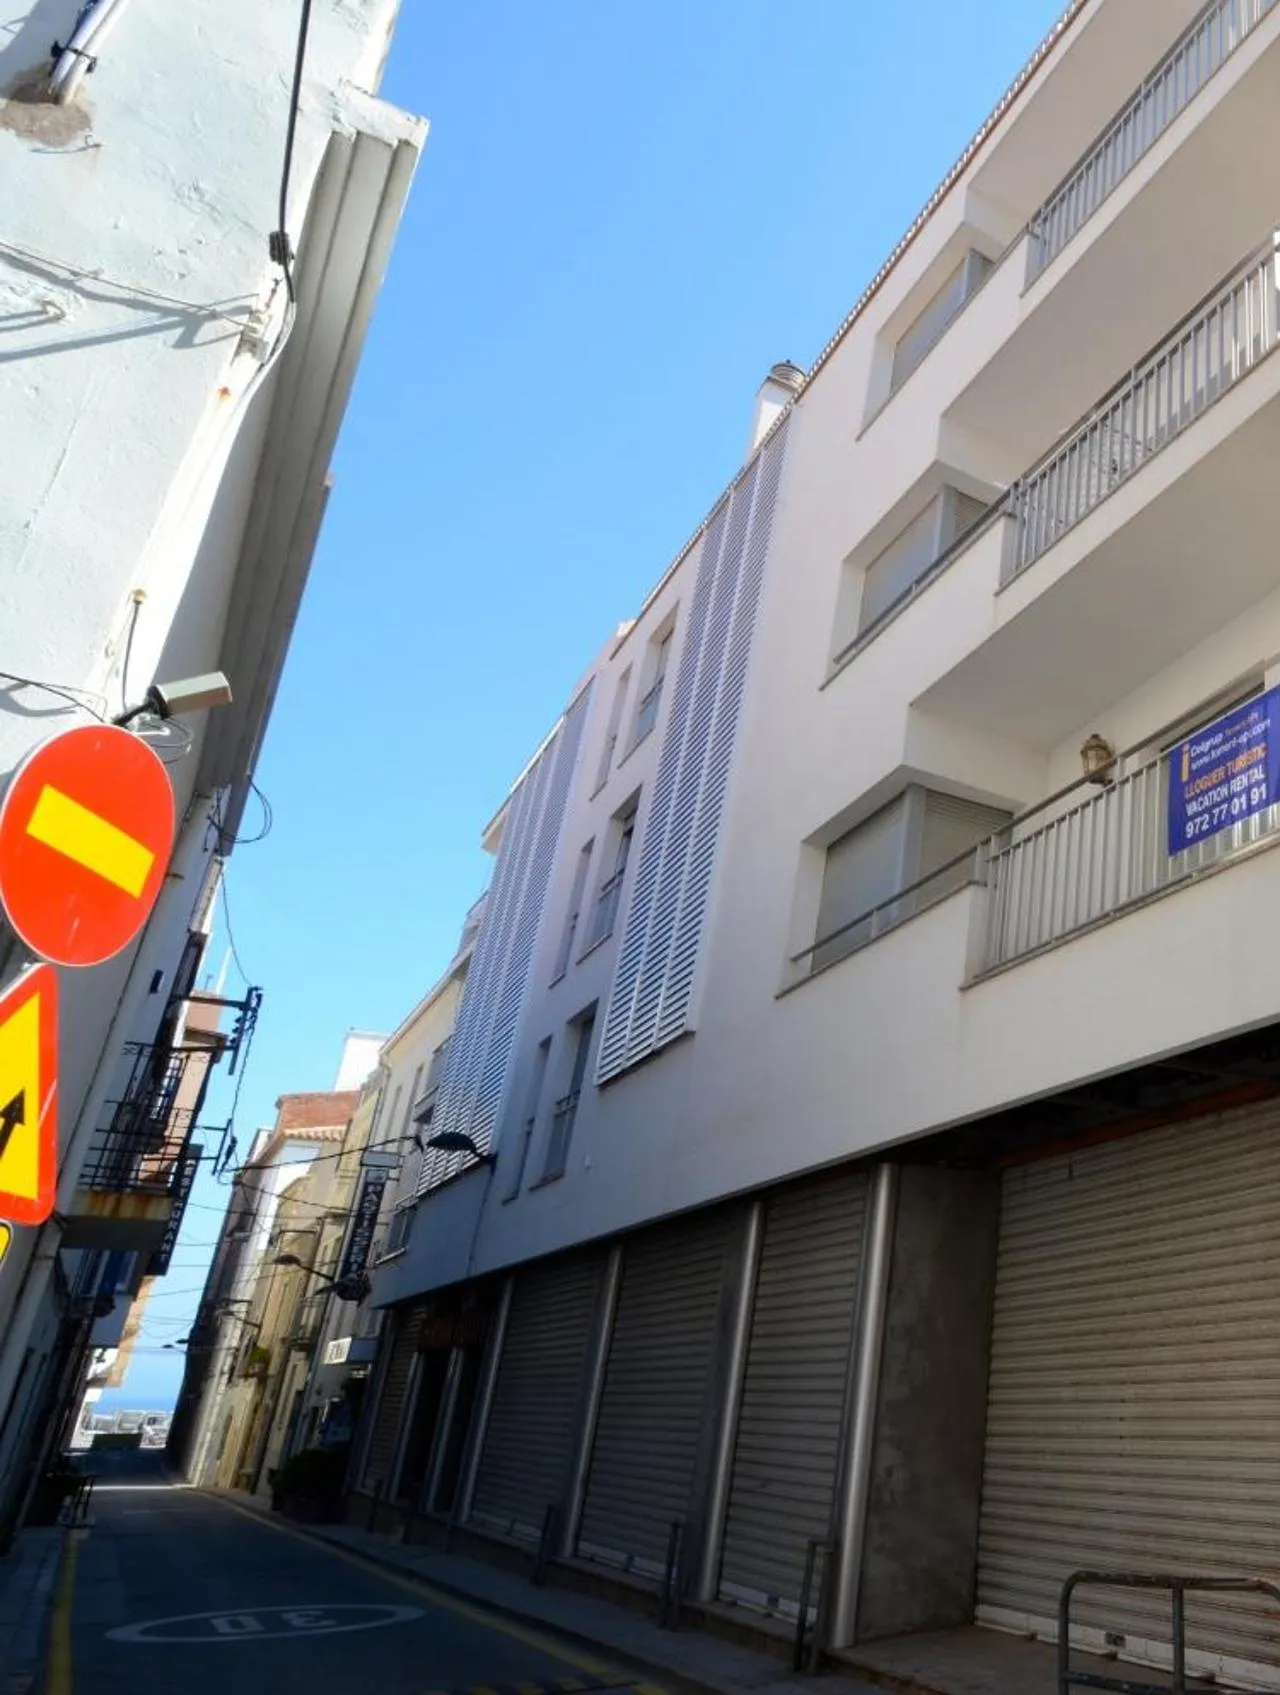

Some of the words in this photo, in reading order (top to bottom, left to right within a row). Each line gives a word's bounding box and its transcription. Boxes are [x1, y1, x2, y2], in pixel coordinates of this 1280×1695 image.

[1185, 812, 1210, 839] 972
[1212, 803, 1229, 824] 77
[1231, 796, 1247, 815] 01
[1250, 783, 1268, 805] 91
[1186, 783, 1229, 817] VACATION
[1230, 764, 1266, 795] RENTAL
